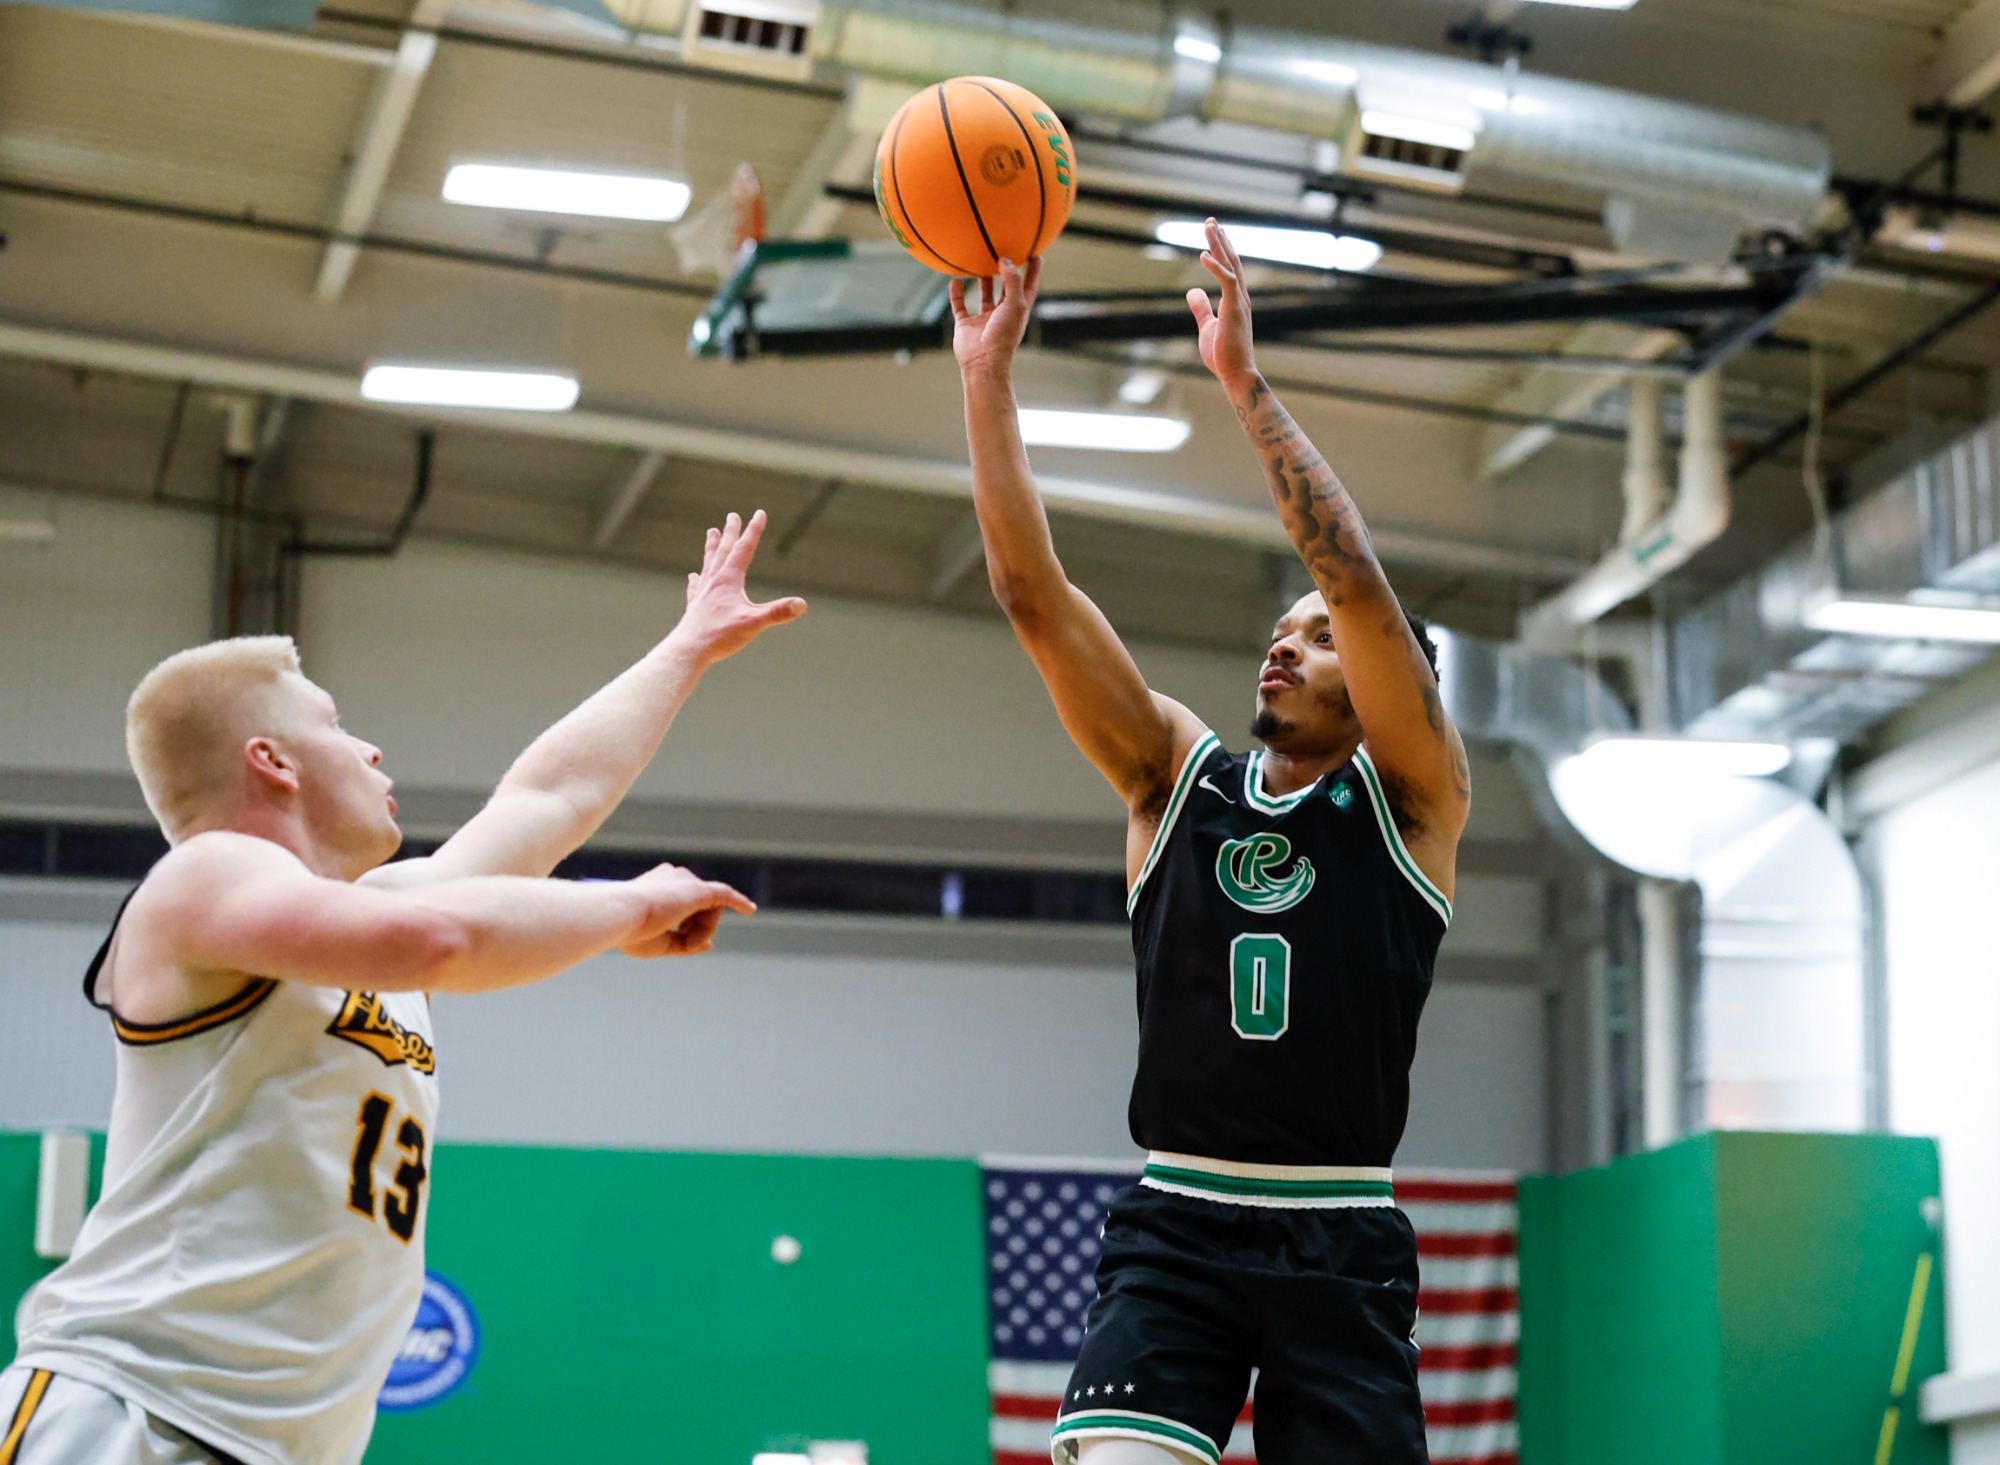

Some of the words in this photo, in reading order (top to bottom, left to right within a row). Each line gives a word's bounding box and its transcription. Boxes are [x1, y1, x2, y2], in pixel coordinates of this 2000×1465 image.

[1032, 111, 1070, 187] EVO
[1229, 932, 1292, 1041] 0
[347, 1089, 426, 1246] 13
